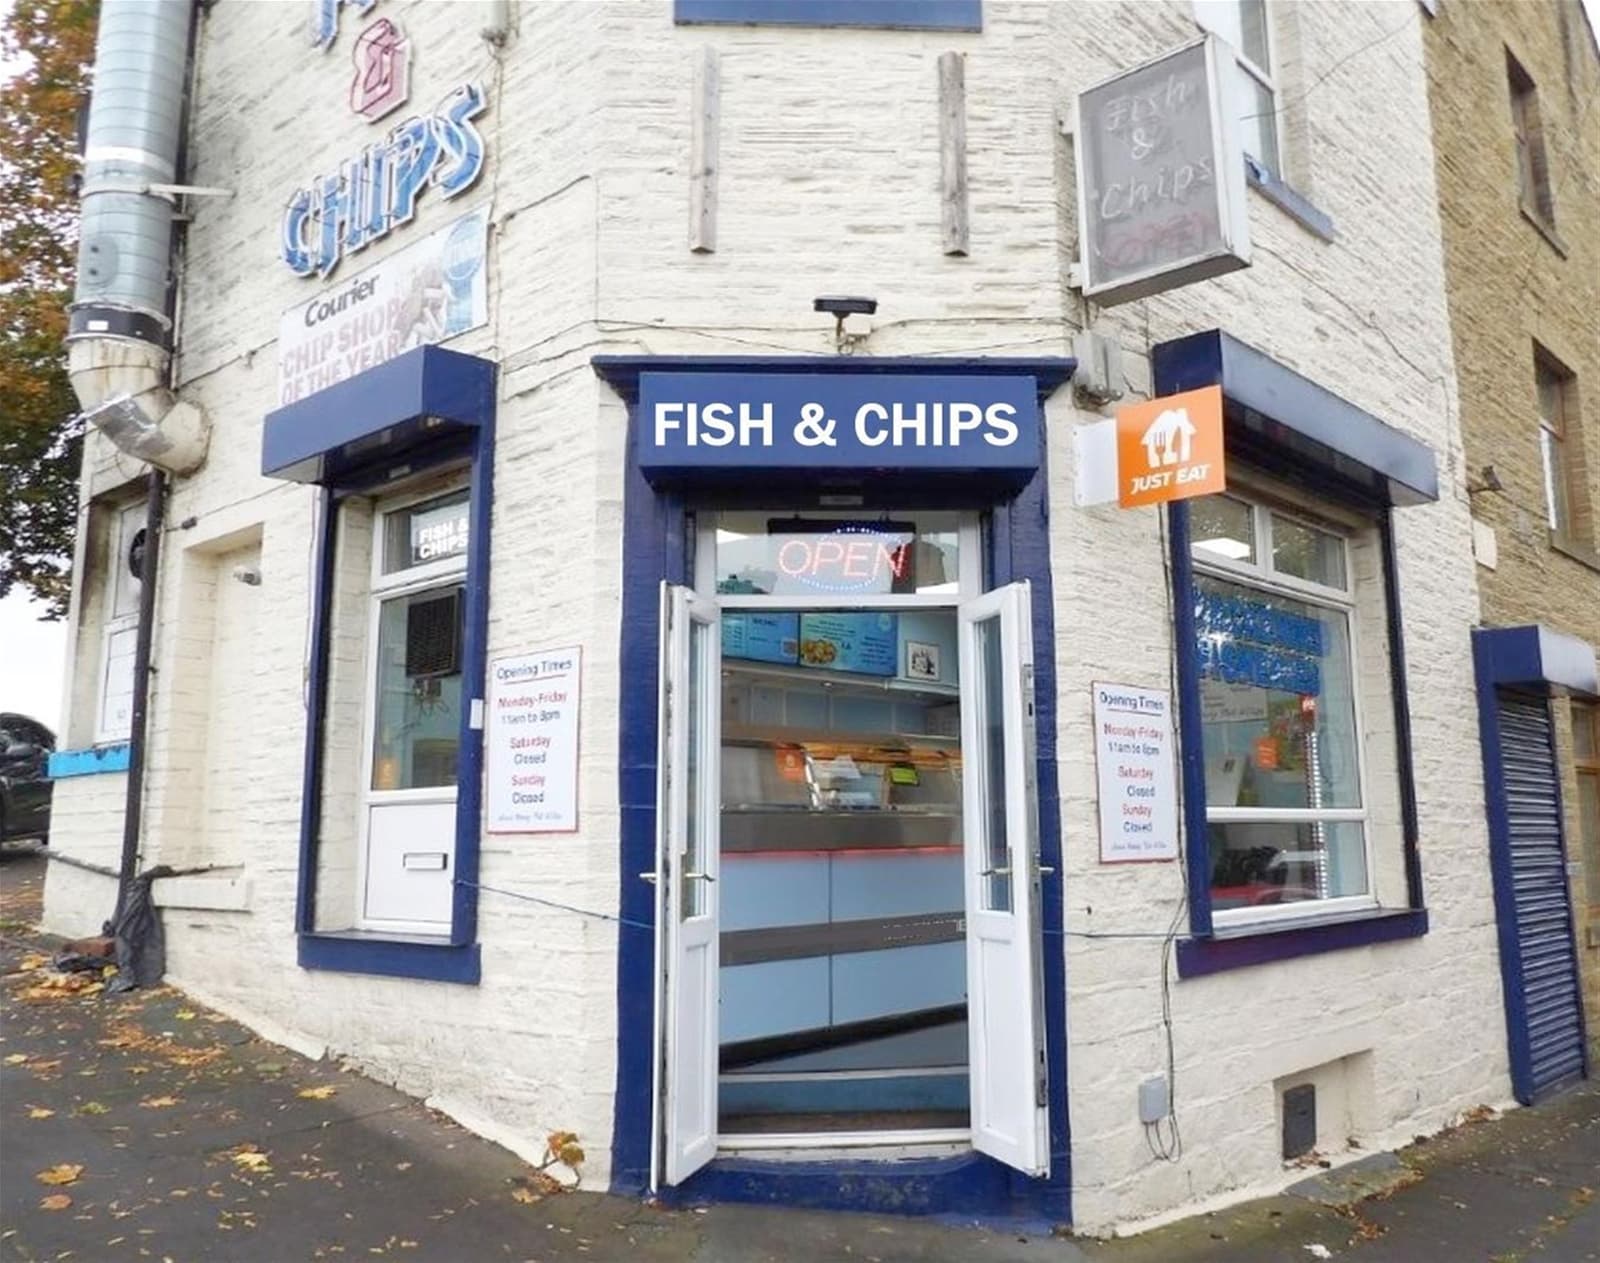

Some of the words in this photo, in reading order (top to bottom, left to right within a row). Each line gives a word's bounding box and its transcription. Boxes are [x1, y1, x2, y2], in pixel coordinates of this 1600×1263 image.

[1107, 74, 1187, 131] Fish
[1131, 127, 1154, 160] &
[281, 80, 485, 280] CHIPS
[1101, 155, 1212, 219] Chips
[304, 273, 380, 328] Courier
[283, 331, 335, 380] CHIP
[338, 296, 408, 353] SHOP
[654, 402, 774, 447] FISH
[793, 402, 837, 447] &
[854, 402, 1019, 447] CHIPS
[1130, 471, 1174, 495] JUST
[1176, 463, 1212, 484] EAT
[419, 521, 453, 546] FISH
[420, 532, 469, 559] CHIPS
[778, 540, 907, 579] OPEN
[497, 664, 539, 682] Opening
[541, 658, 573, 674] Times
[1099, 691, 1137, 709] Opening
[1138, 696, 1164, 710] Times
[510, 733, 551, 751] Saturday
[513, 751, 547, 766] Closed
[511, 774, 546, 789] Sunday
[1117, 765, 1154, 781] Saturday
[511, 791, 545, 805] Closed
[1126, 785, 1156, 798] Closed
[1121, 803, 1153, 819] Sunday
[1122, 821, 1152, 834] Closed
